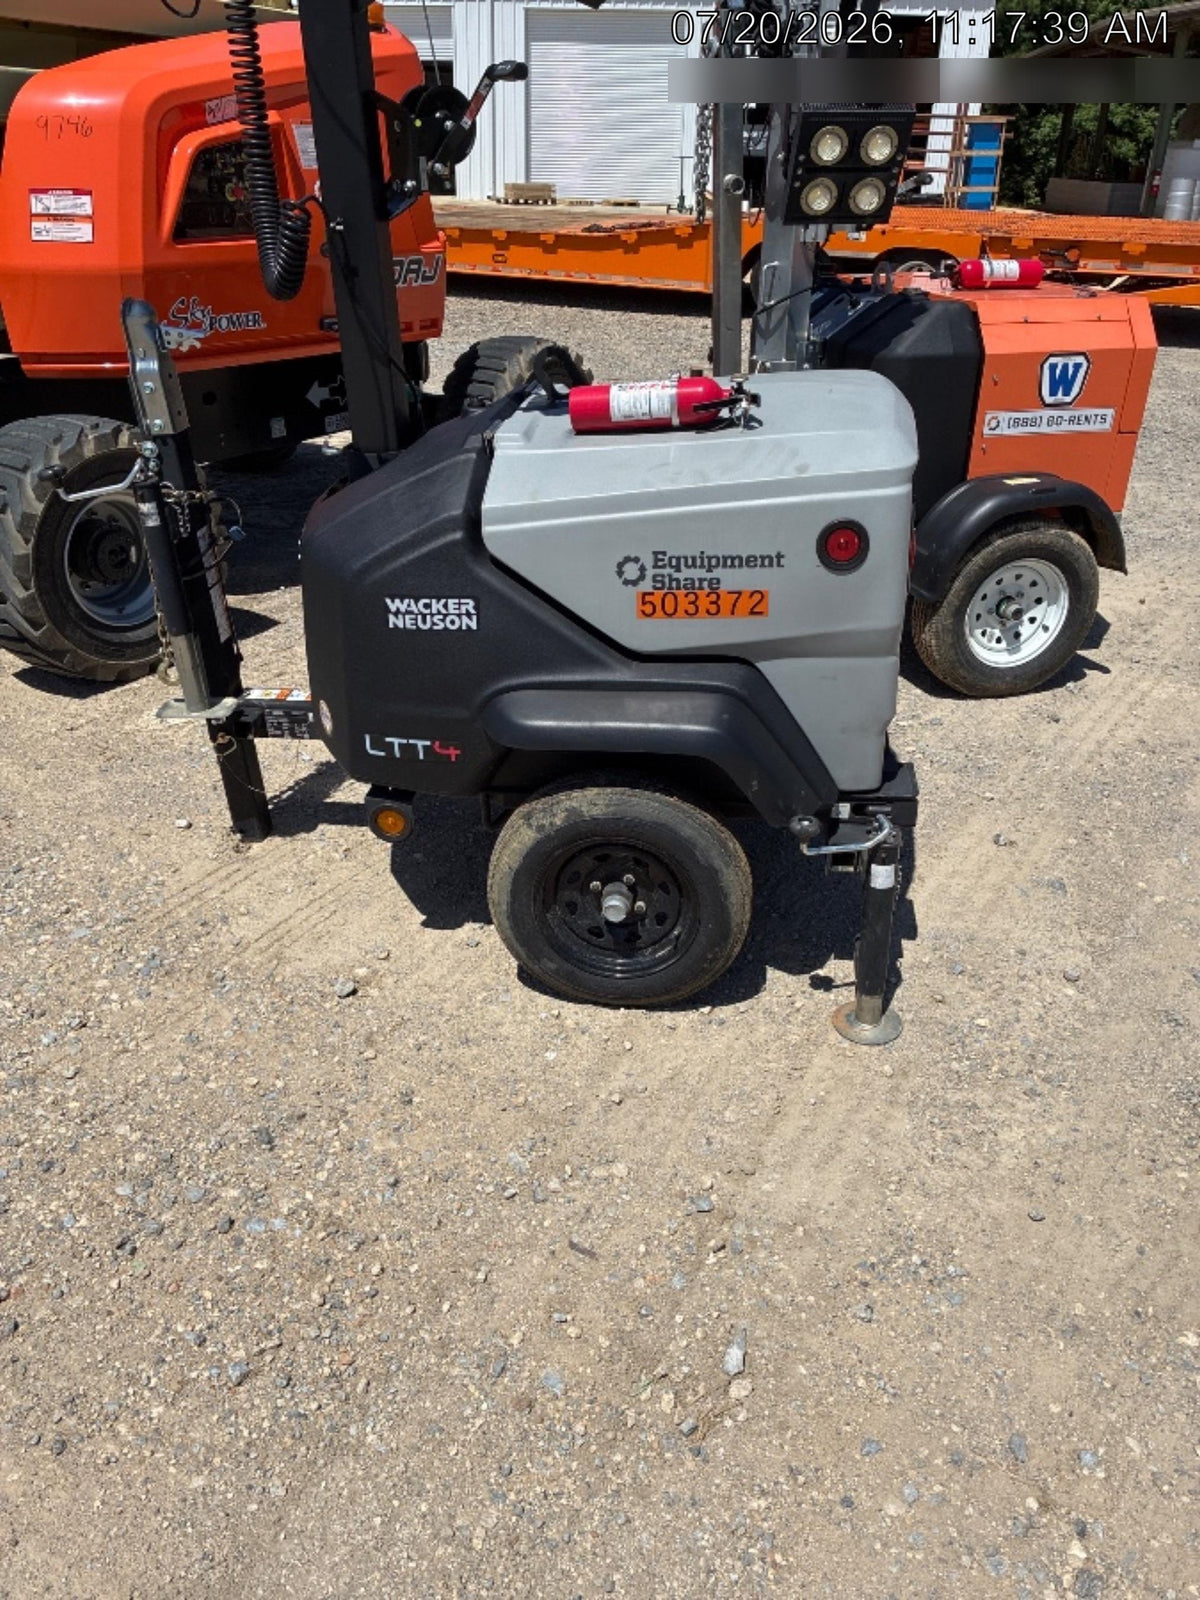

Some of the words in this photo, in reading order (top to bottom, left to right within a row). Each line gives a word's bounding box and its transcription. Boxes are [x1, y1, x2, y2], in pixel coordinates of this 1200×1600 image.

[35, 114, 93, 141] 9746
[169, 296, 213, 336] Sky
[208, 311, 262, 332] POWER
[1048, 362, 1084, 397] W
[651, 550, 786, 573] Equipment
[651, 573, 722, 591] Share
[385, 597, 477, 614] WACKER
[640, 590, 766, 618] 503372
[388, 613, 478, 631] NEUSON
[364, 734, 461, 762] LTT4
